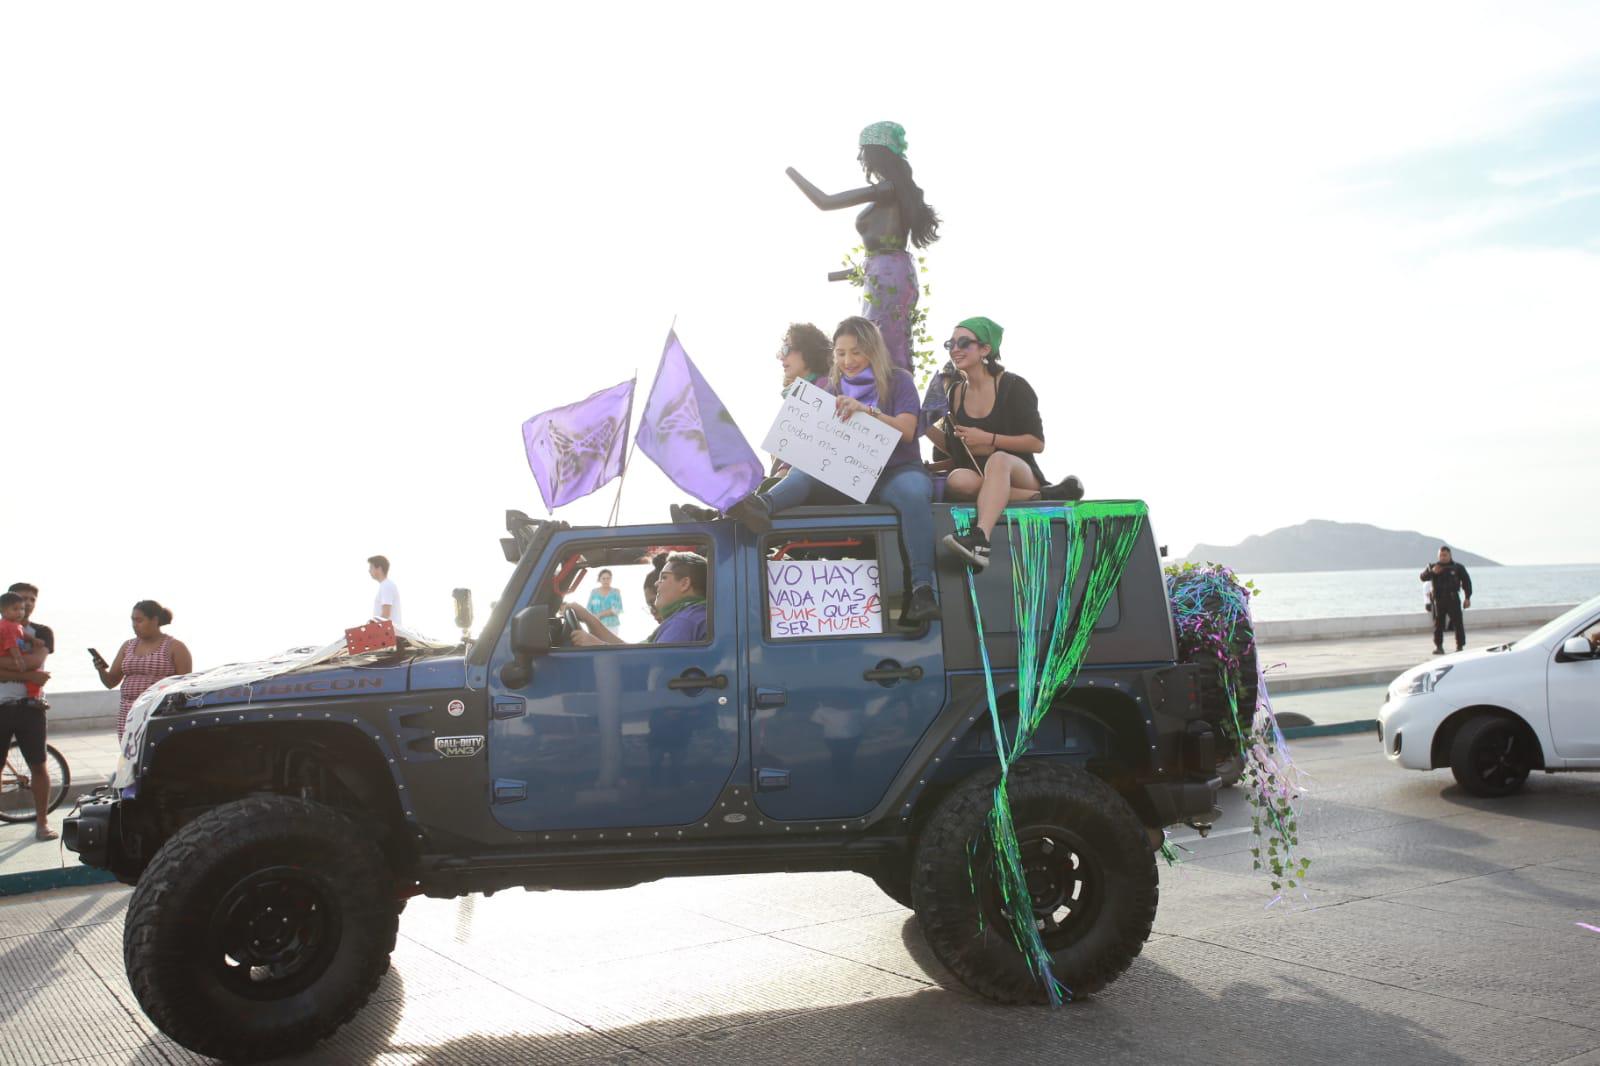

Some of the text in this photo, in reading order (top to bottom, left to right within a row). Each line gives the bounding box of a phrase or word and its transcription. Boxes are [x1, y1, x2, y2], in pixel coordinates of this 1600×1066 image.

[787, 405, 879, 457] me cuida me
[811, 564, 863, 586] HAY
[821, 588, 866, 602] MAS
[823, 603, 860, 618] QUE
[776, 615, 871, 635] SER MUJER
[216, 677, 384, 701] RUBICON
[460, 737, 481, 747] DUTY
